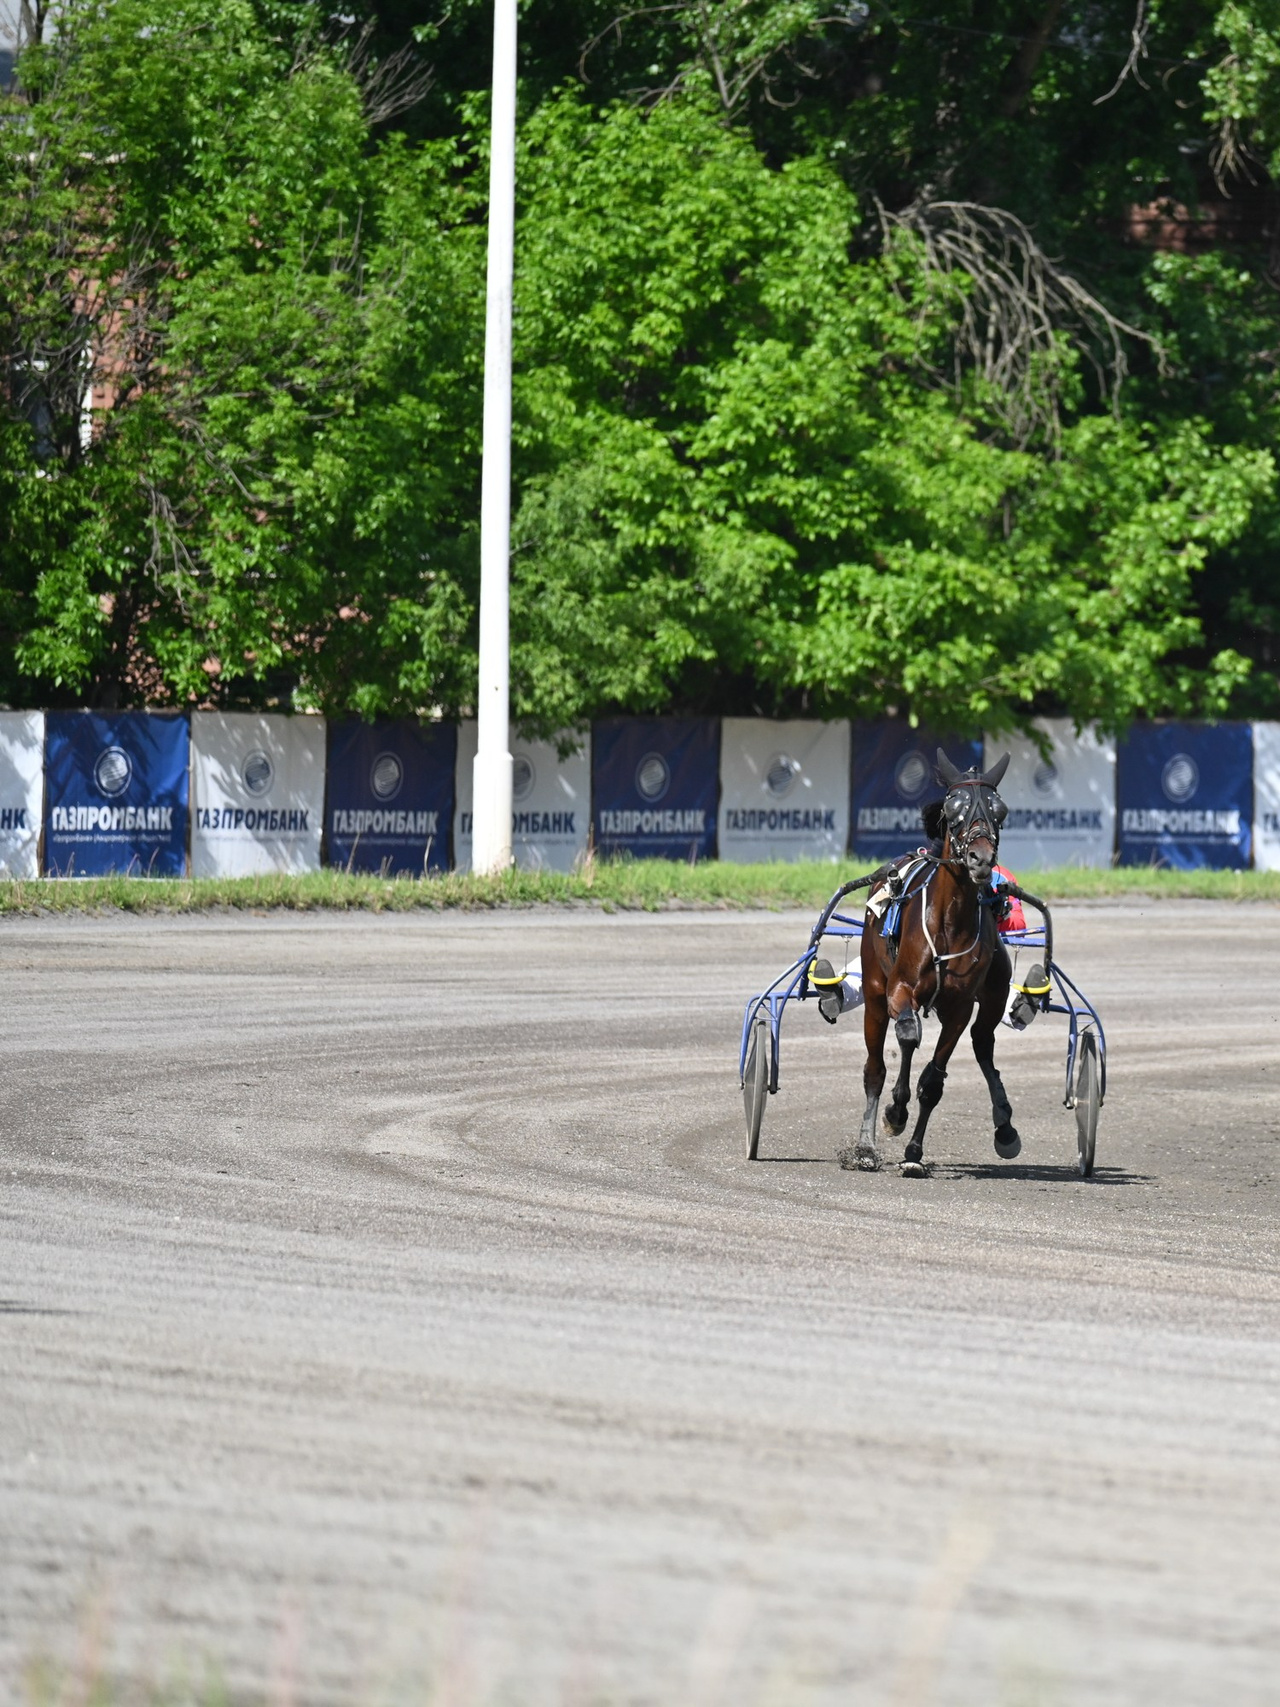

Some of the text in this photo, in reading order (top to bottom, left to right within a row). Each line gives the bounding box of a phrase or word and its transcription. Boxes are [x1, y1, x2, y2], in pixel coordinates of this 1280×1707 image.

[52, 806, 173, 831] ГАЗПРОМБАНК
[196, 808, 309, 830] ГАЗПРОМБАНК
[333, 810, 439, 834] ГАЗПРОМБАНК
[600, 810, 705, 833] ГАЗПРОМБАНК
[726, 809, 836, 830] ГАЗПРОМБАНК
[857, 808, 925, 831] ГАЗПРОМ
[1122, 809, 1240, 834] ГАЗПРОМБАНК
